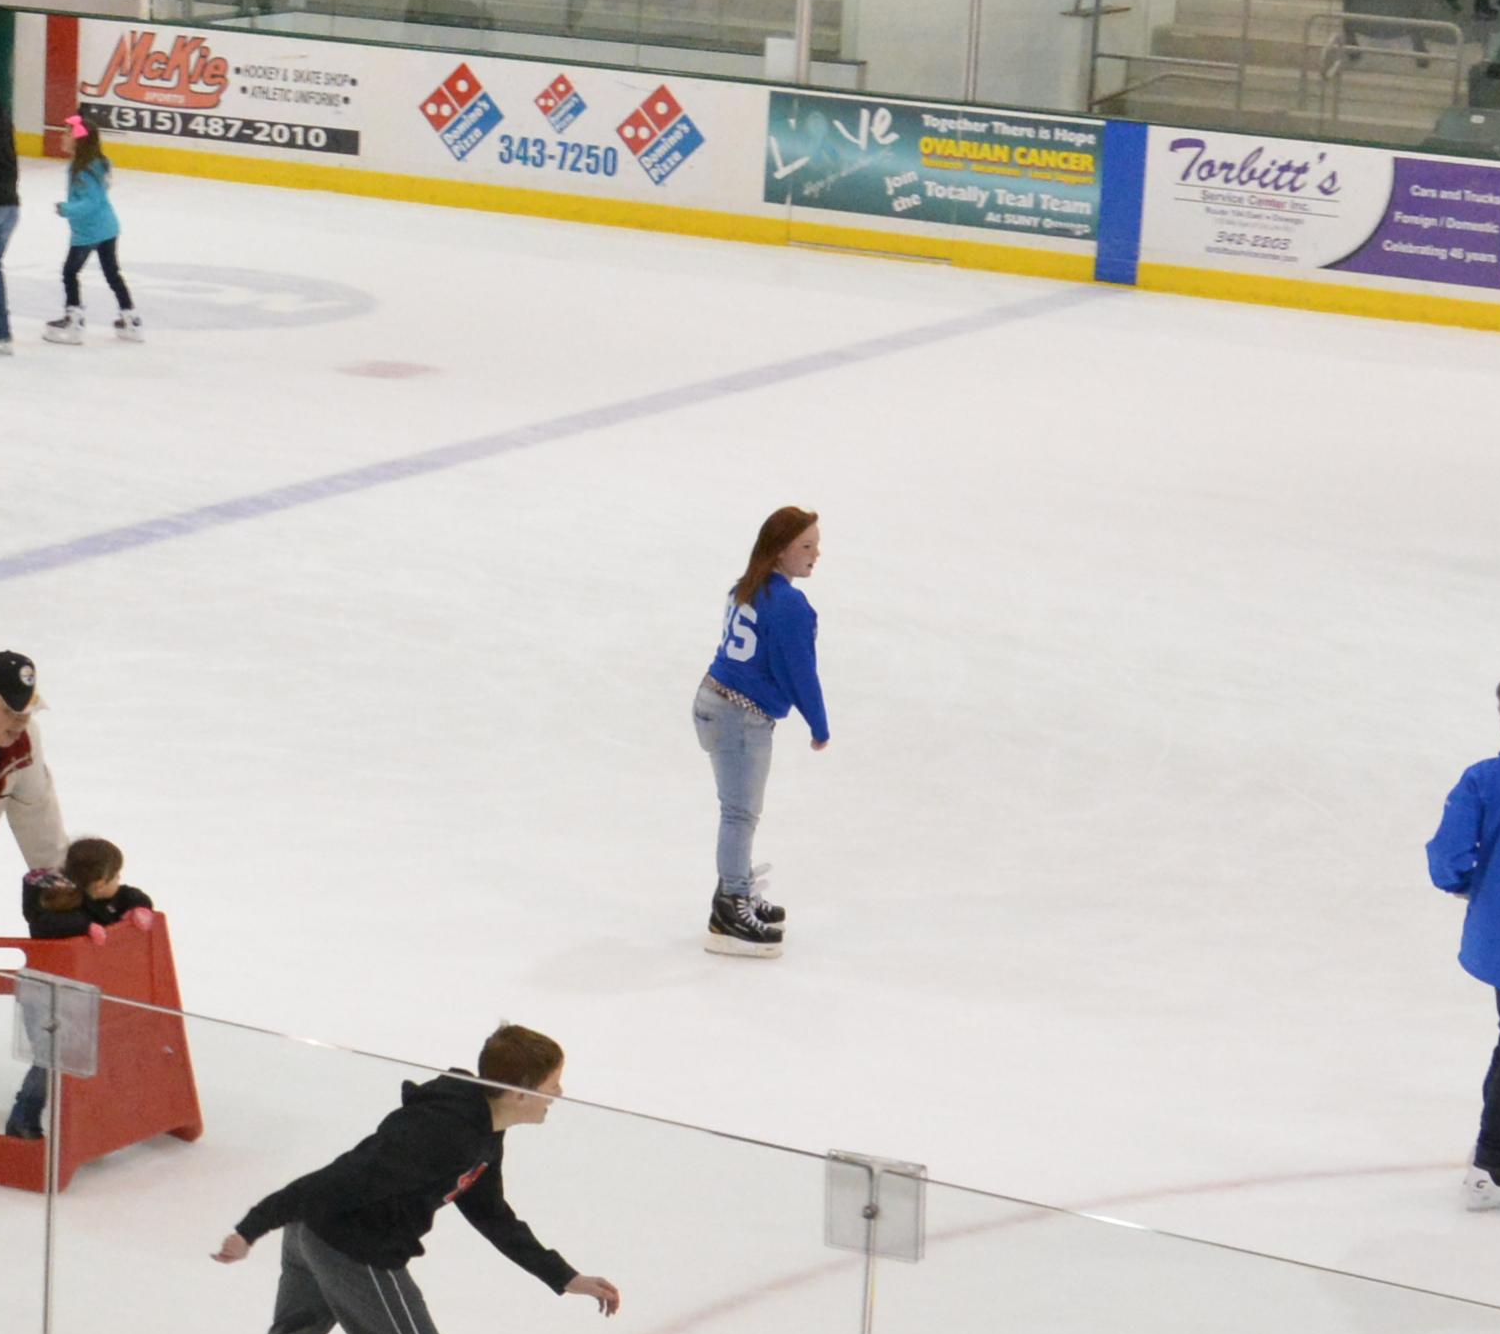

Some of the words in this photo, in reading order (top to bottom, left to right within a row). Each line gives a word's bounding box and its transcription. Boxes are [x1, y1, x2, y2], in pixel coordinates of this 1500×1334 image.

[81, 30, 229, 97] McKie
[243, 65, 279, 82] HOCKEY
[292, 68, 322, 85] SKATE
[324, 72, 349, 87] SHOP
[250, 85, 291, 103] ATHLETIC
[294, 90, 342, 107] UNIFORMS
[109, 107, 182, 135] (315)
[188, 115, 328, 148] 487-2010
[442, 99, 490, 144] Domino's
[922, 114, 989, 133] Together
[991, 121, 1036, 139] There
[1038, 126, 1051, 139] is
[1053, 127, 1097, 147] Hope
[450, 128, 483, 159] Pizza
[498, 133, 619, 177] 343-7250
[640, 121, 691, 169] Domino's
[919, 136, 1011, 164] OVARIAN
[1015, 146, 1096, 173] CANCER
[648, 151, 684, 182] Pizza
[1168, 137, 1342, 196] Torbitt's
[923, 180, 990, 208] Totally
[994, 188, 1035, 209] Teal
[1039, 193, 1092, 216] Team
[1201, 190, 1245, 205] Service
[1247, 194, 1287, 210] Center
[1409, 184, 1438, 199] Cars
[1439, 189, 1462, 201] and
[1393, 211, 1438, 229] Foreign
[1445, 217, 1500, 234] Domestic
[1381, 239, 1448, 260] Celebrating
